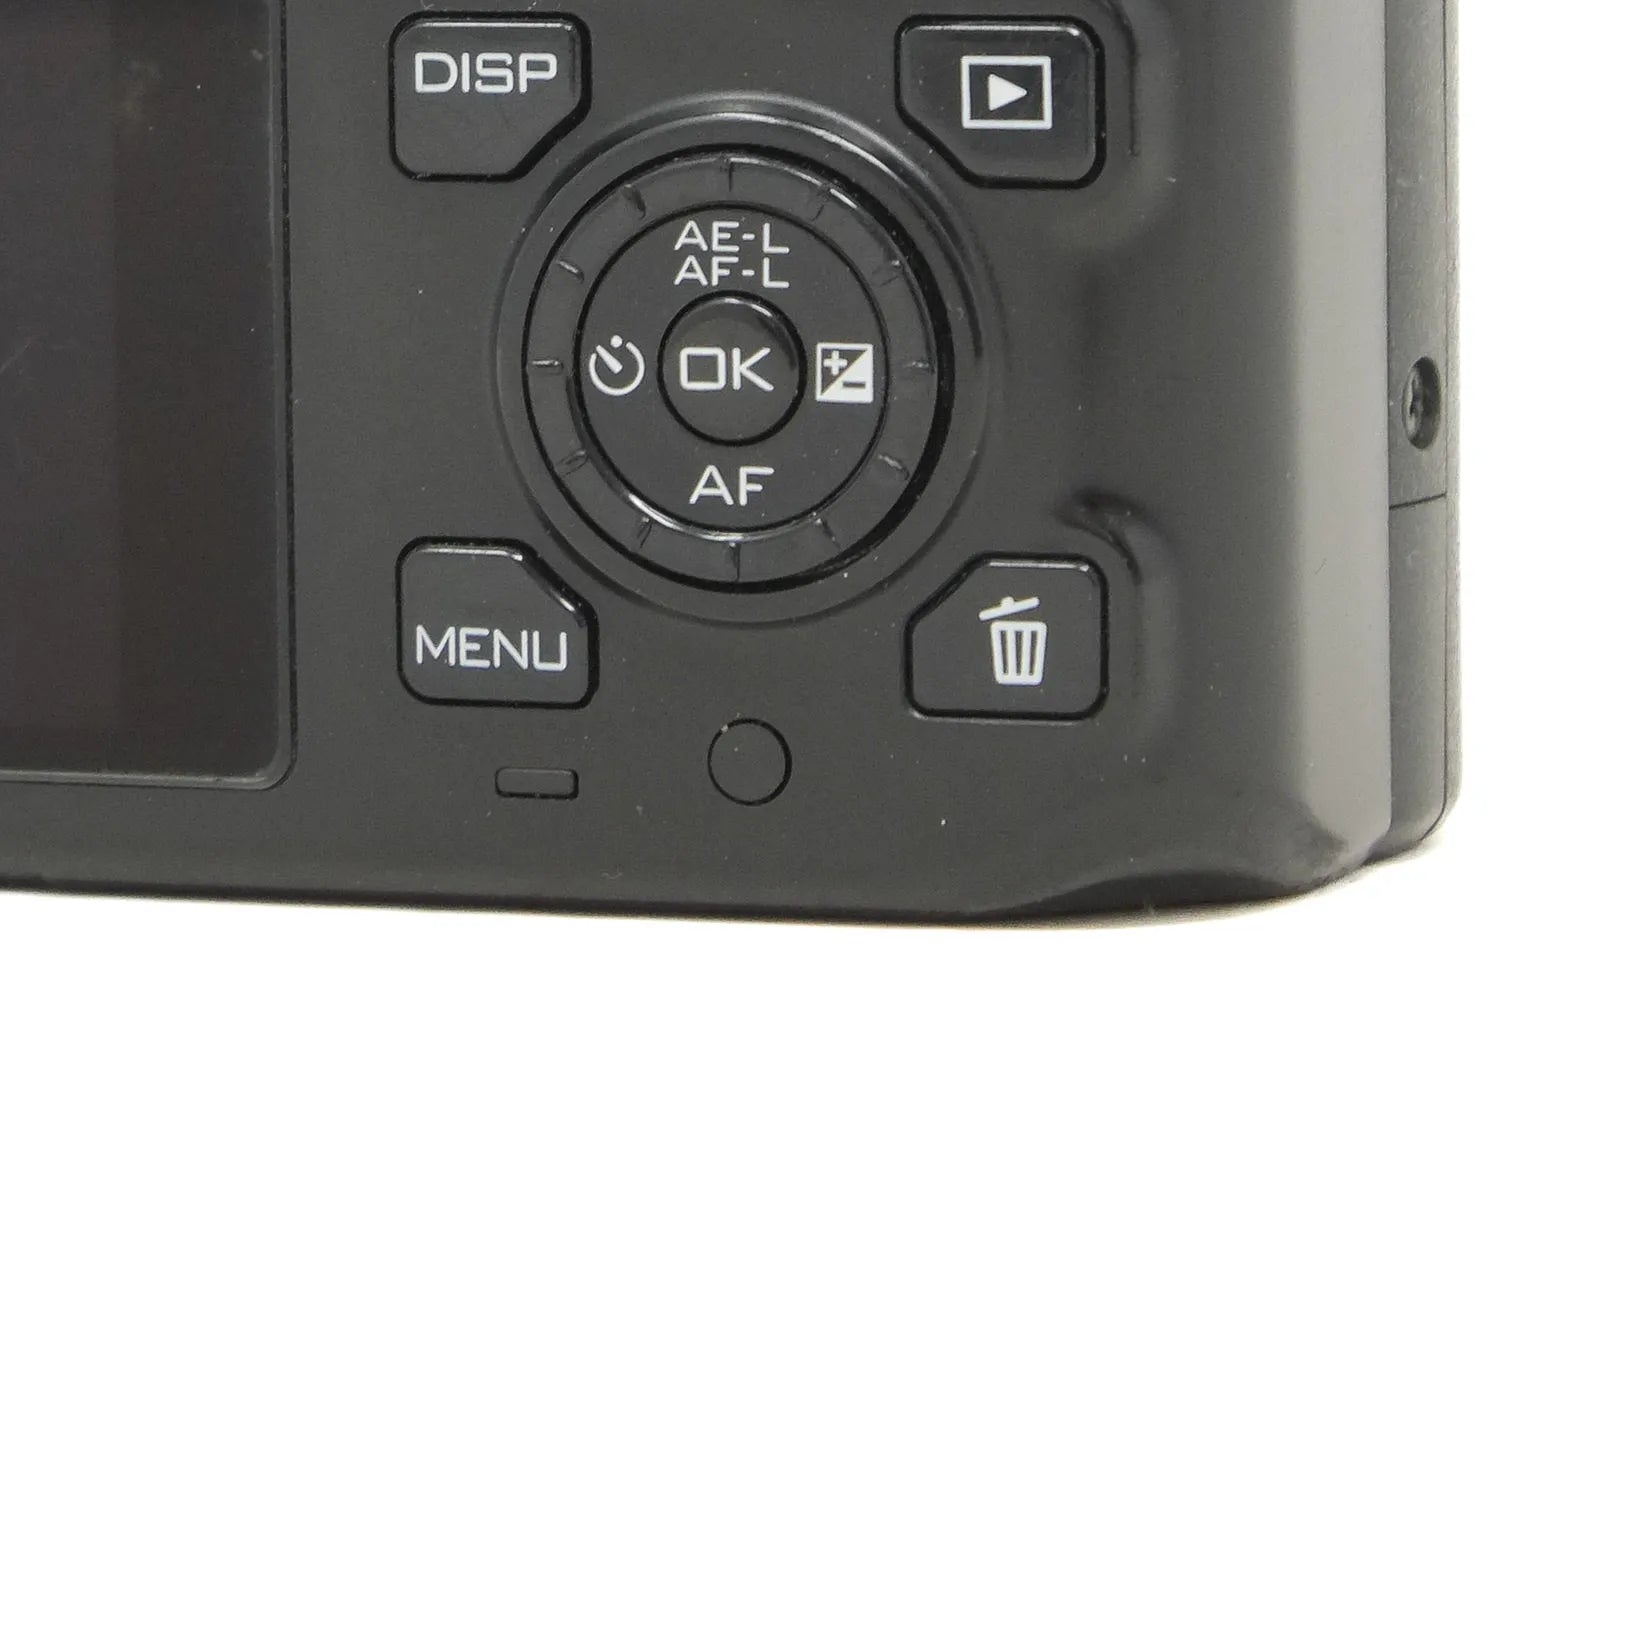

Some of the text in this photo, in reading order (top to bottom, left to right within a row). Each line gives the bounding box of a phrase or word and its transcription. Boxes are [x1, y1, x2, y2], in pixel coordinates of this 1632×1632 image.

[413, 51, 558, 95] DISP
[673, 219, 790, 255] AE-L
[673, 255, 790, 289] AF-L
[678, 345, 775, 392] OK
[688, 464, 775, 507] AF
[414, 627, 569, 672] MENU
